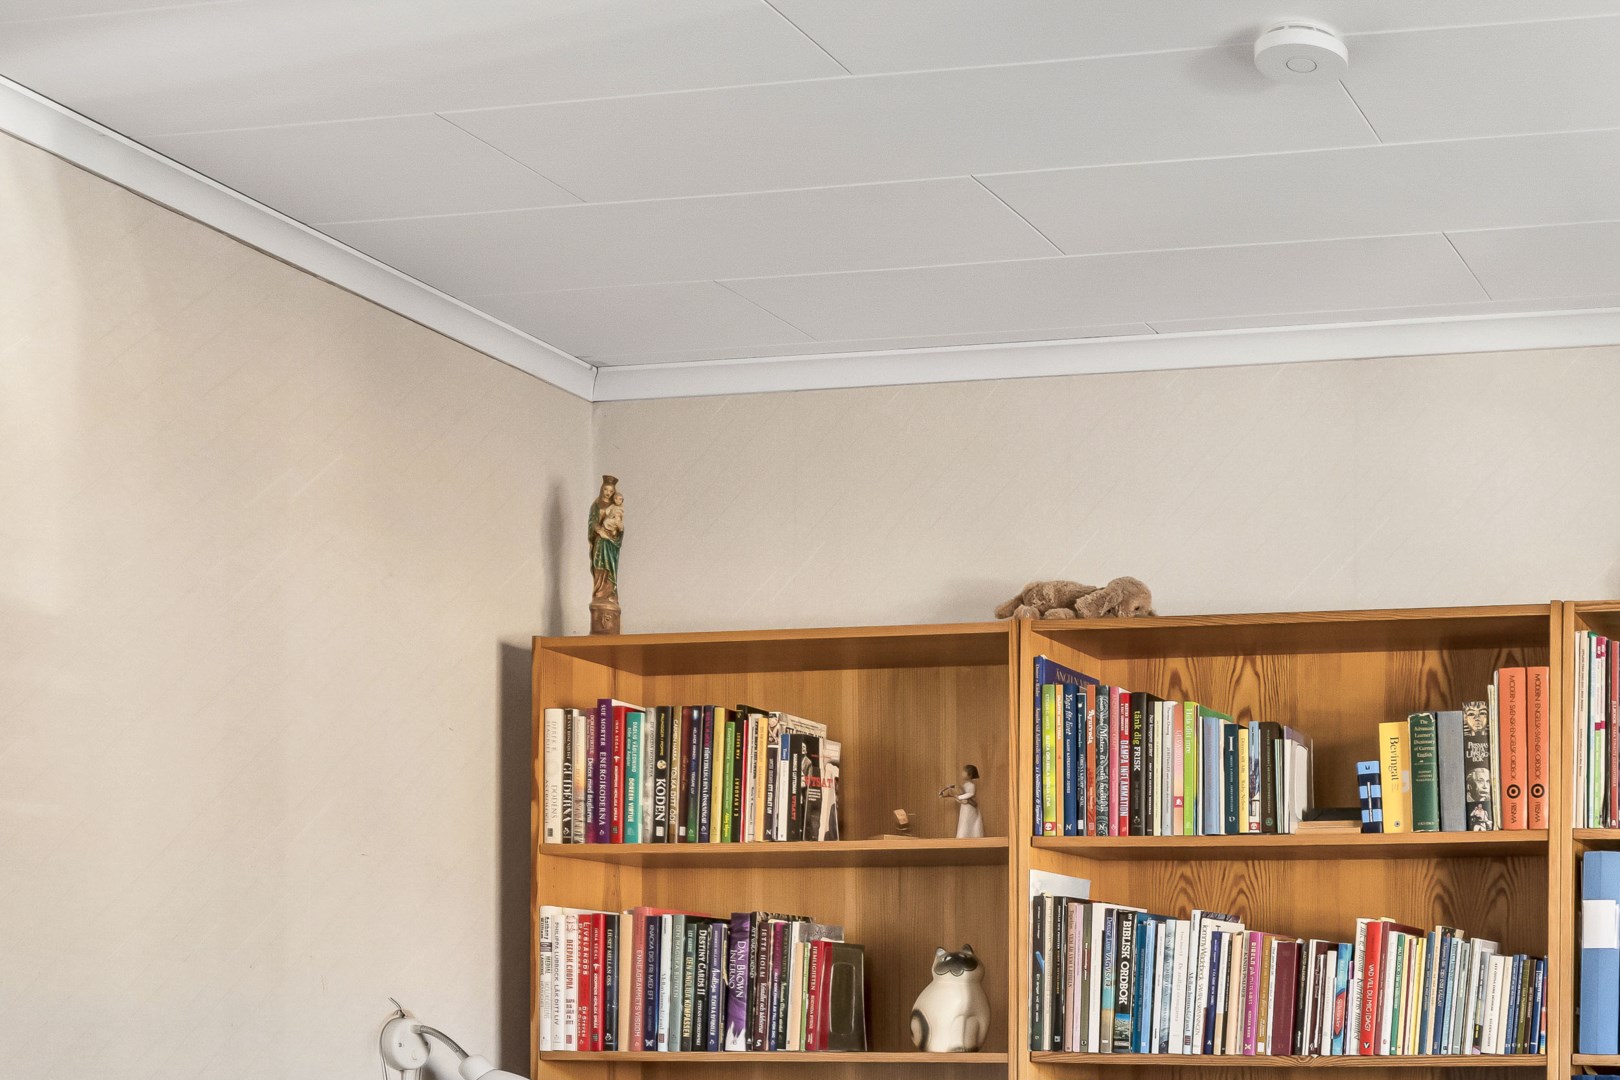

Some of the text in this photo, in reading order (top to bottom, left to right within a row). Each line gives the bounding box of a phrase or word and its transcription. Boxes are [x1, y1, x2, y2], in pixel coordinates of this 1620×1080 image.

[1064, 694, 1073, 709] Yoga
[1133, 711, 1142, 771] tänk dig FRISK
[1388, 737, 1399, 780] Bevingat
[563, 762, 572, 822] GUIDERNA
[599, 751, 607, 826] ENERGIKODERNA
[670, 766, 678, 789] TOLKA
[1119, 740, 1129, 817] DAMPA INFLAMMATION
[655, 778, 666, 821] KODEN
[698, 930, 706, 961] DESTINY
[1121, 921, 1132, 959] BIBLISK
[698, 963, 706, 987] CARDS
[729, 949, 737, 989] INFERNO
[736, 940, 746, 998] DAN BROWN
[1119, 961, 1130, 1005] ORDBOK
[1366, 978, 1374, 989] VILL
[1367, 964, 1375, 977] VAD
[1365, 1001, 1373, 1012] MIG
[1366, 990, 1373, 1000] DU
[683, 1000, 692, 1037] KOMPASSEN
